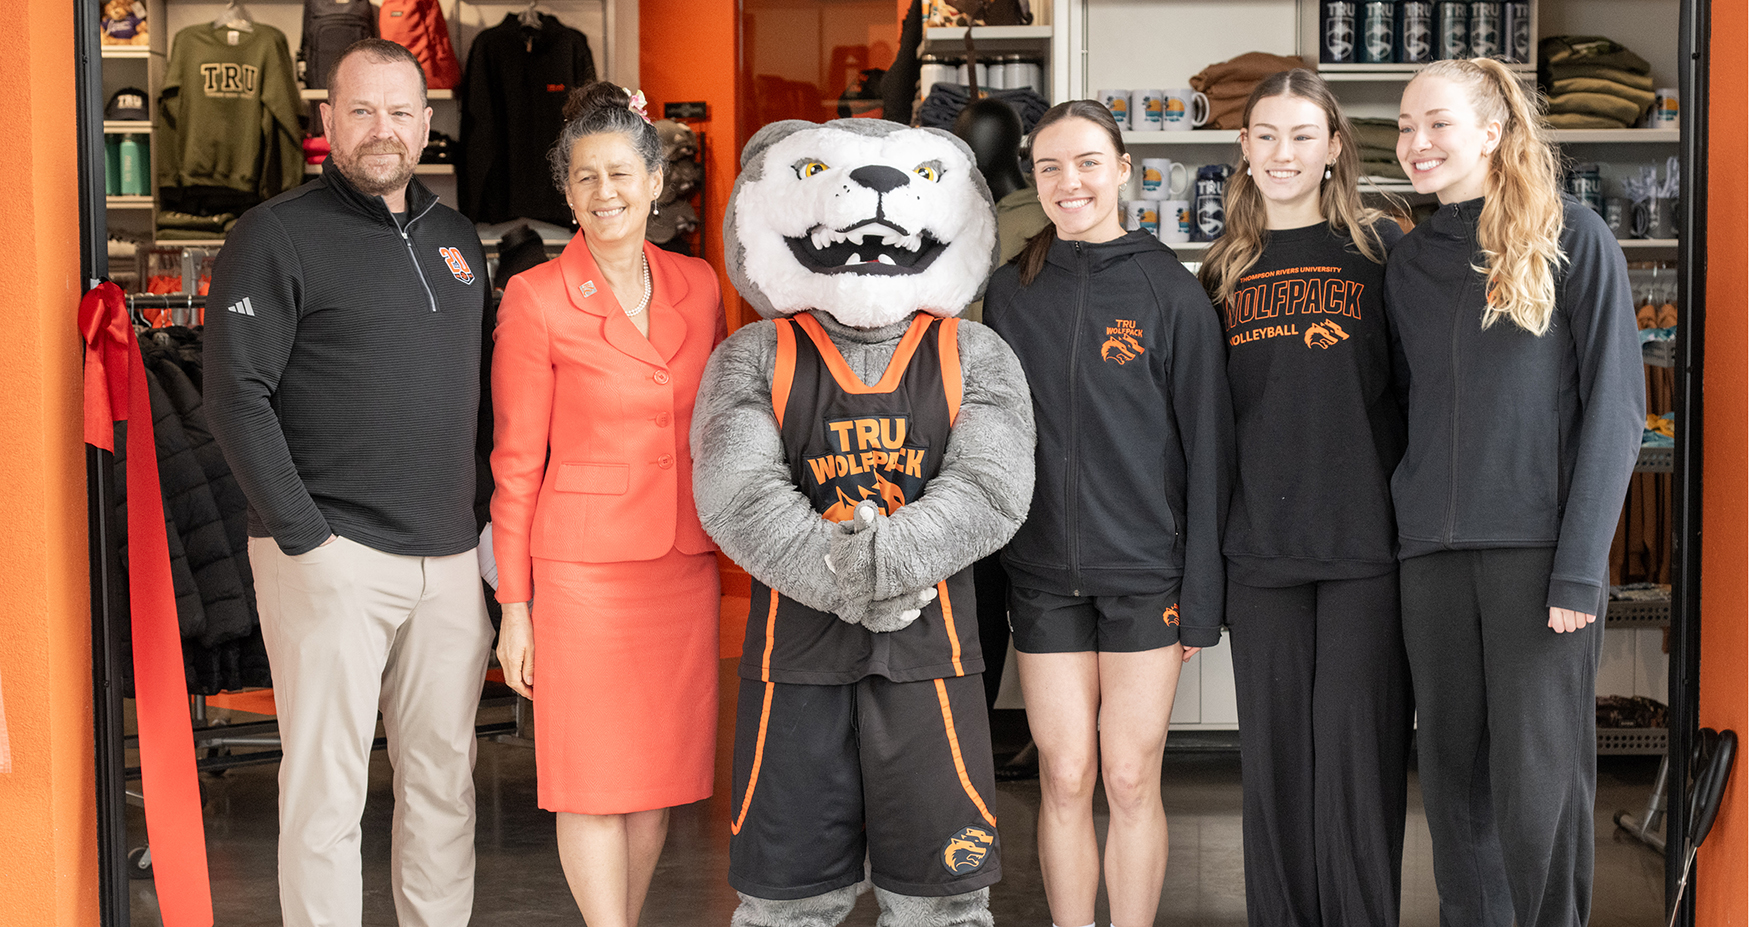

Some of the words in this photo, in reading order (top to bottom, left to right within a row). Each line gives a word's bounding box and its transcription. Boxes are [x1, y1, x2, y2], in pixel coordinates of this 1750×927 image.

[1327, 2, 1355, 16] TRU
[1366, 2, 1394, 16] TRU
[1404, 2, 1432, 17] TRU
[1471, 2, 1500, 17] TRU
[201, 63, 258, 95] TRU
[117, 94, 142, 109] TRU
[1573, 178, 1601, 193] TRU
[439, 247, 471, 273] 20
[1240, 271, 1275, 283] THOMPSON
[1275, 267, 1300, 276] RIVERS
[1222, 278, 1365, 332] WOLFPACK
[1115, 319, 1136, 329] TRU
[1106, 327, 1143, 338] WOLFPACK
[1229, 323, 1299, 346] VOLLEYBALL
[828, 418, 906, 452] TRU
[807, 448, 925, 485] WOLFPACK
